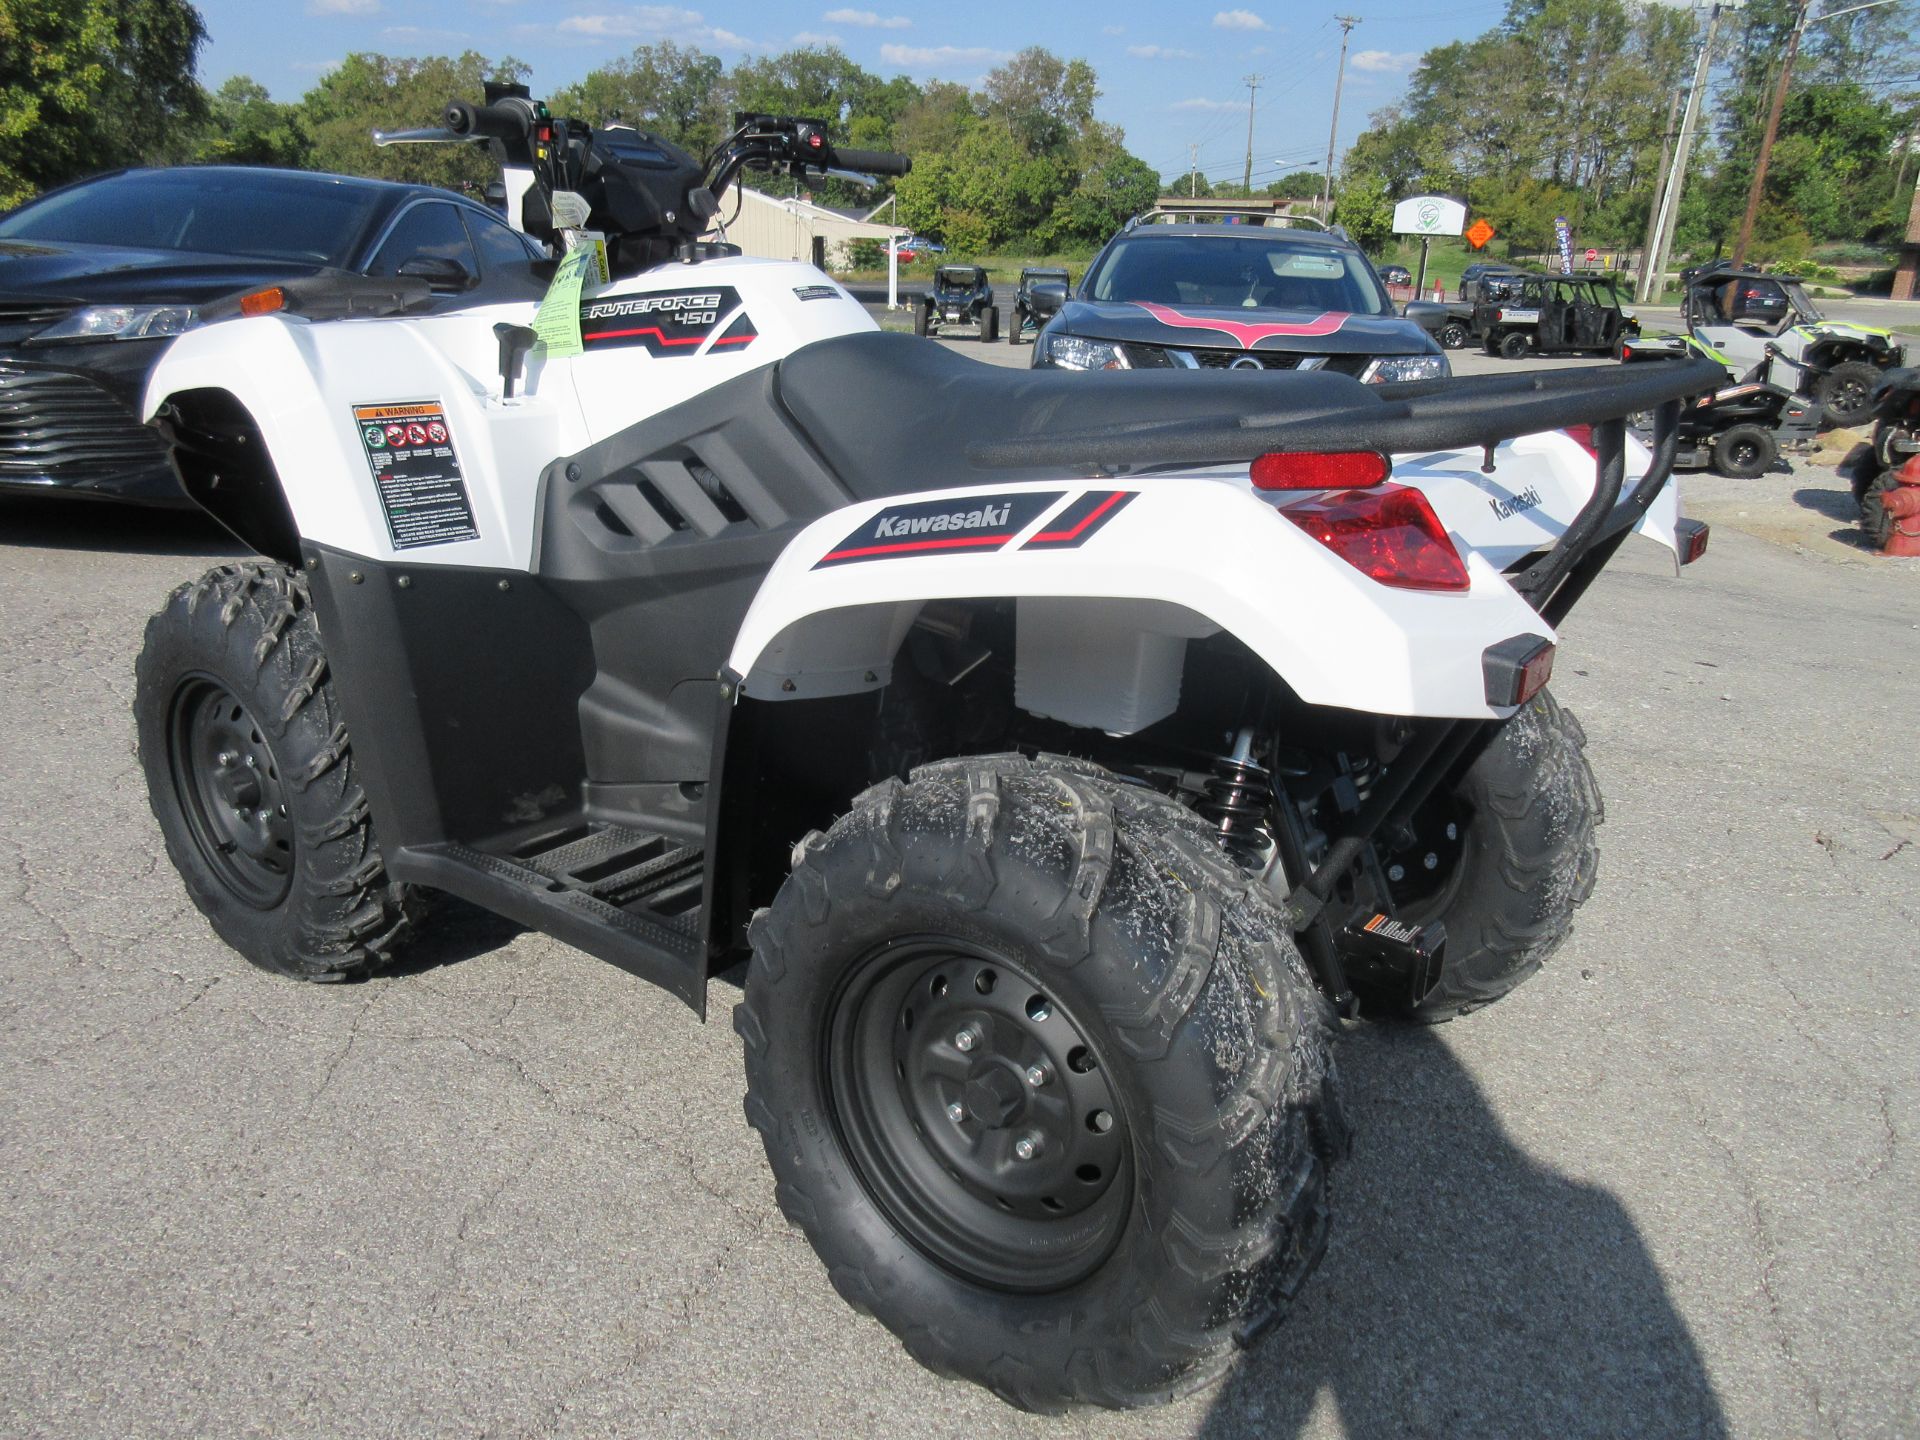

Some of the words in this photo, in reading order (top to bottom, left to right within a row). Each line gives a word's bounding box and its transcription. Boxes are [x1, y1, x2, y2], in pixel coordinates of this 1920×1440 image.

[645, 294, 721, 312] FORCE
[674, 311, 716, 325] 450
[384, 406, 425, 417] WARNING
[1488, 484, 1542, 521] Kawasaki
[874, 503, 1012, 539] Kawasaki
